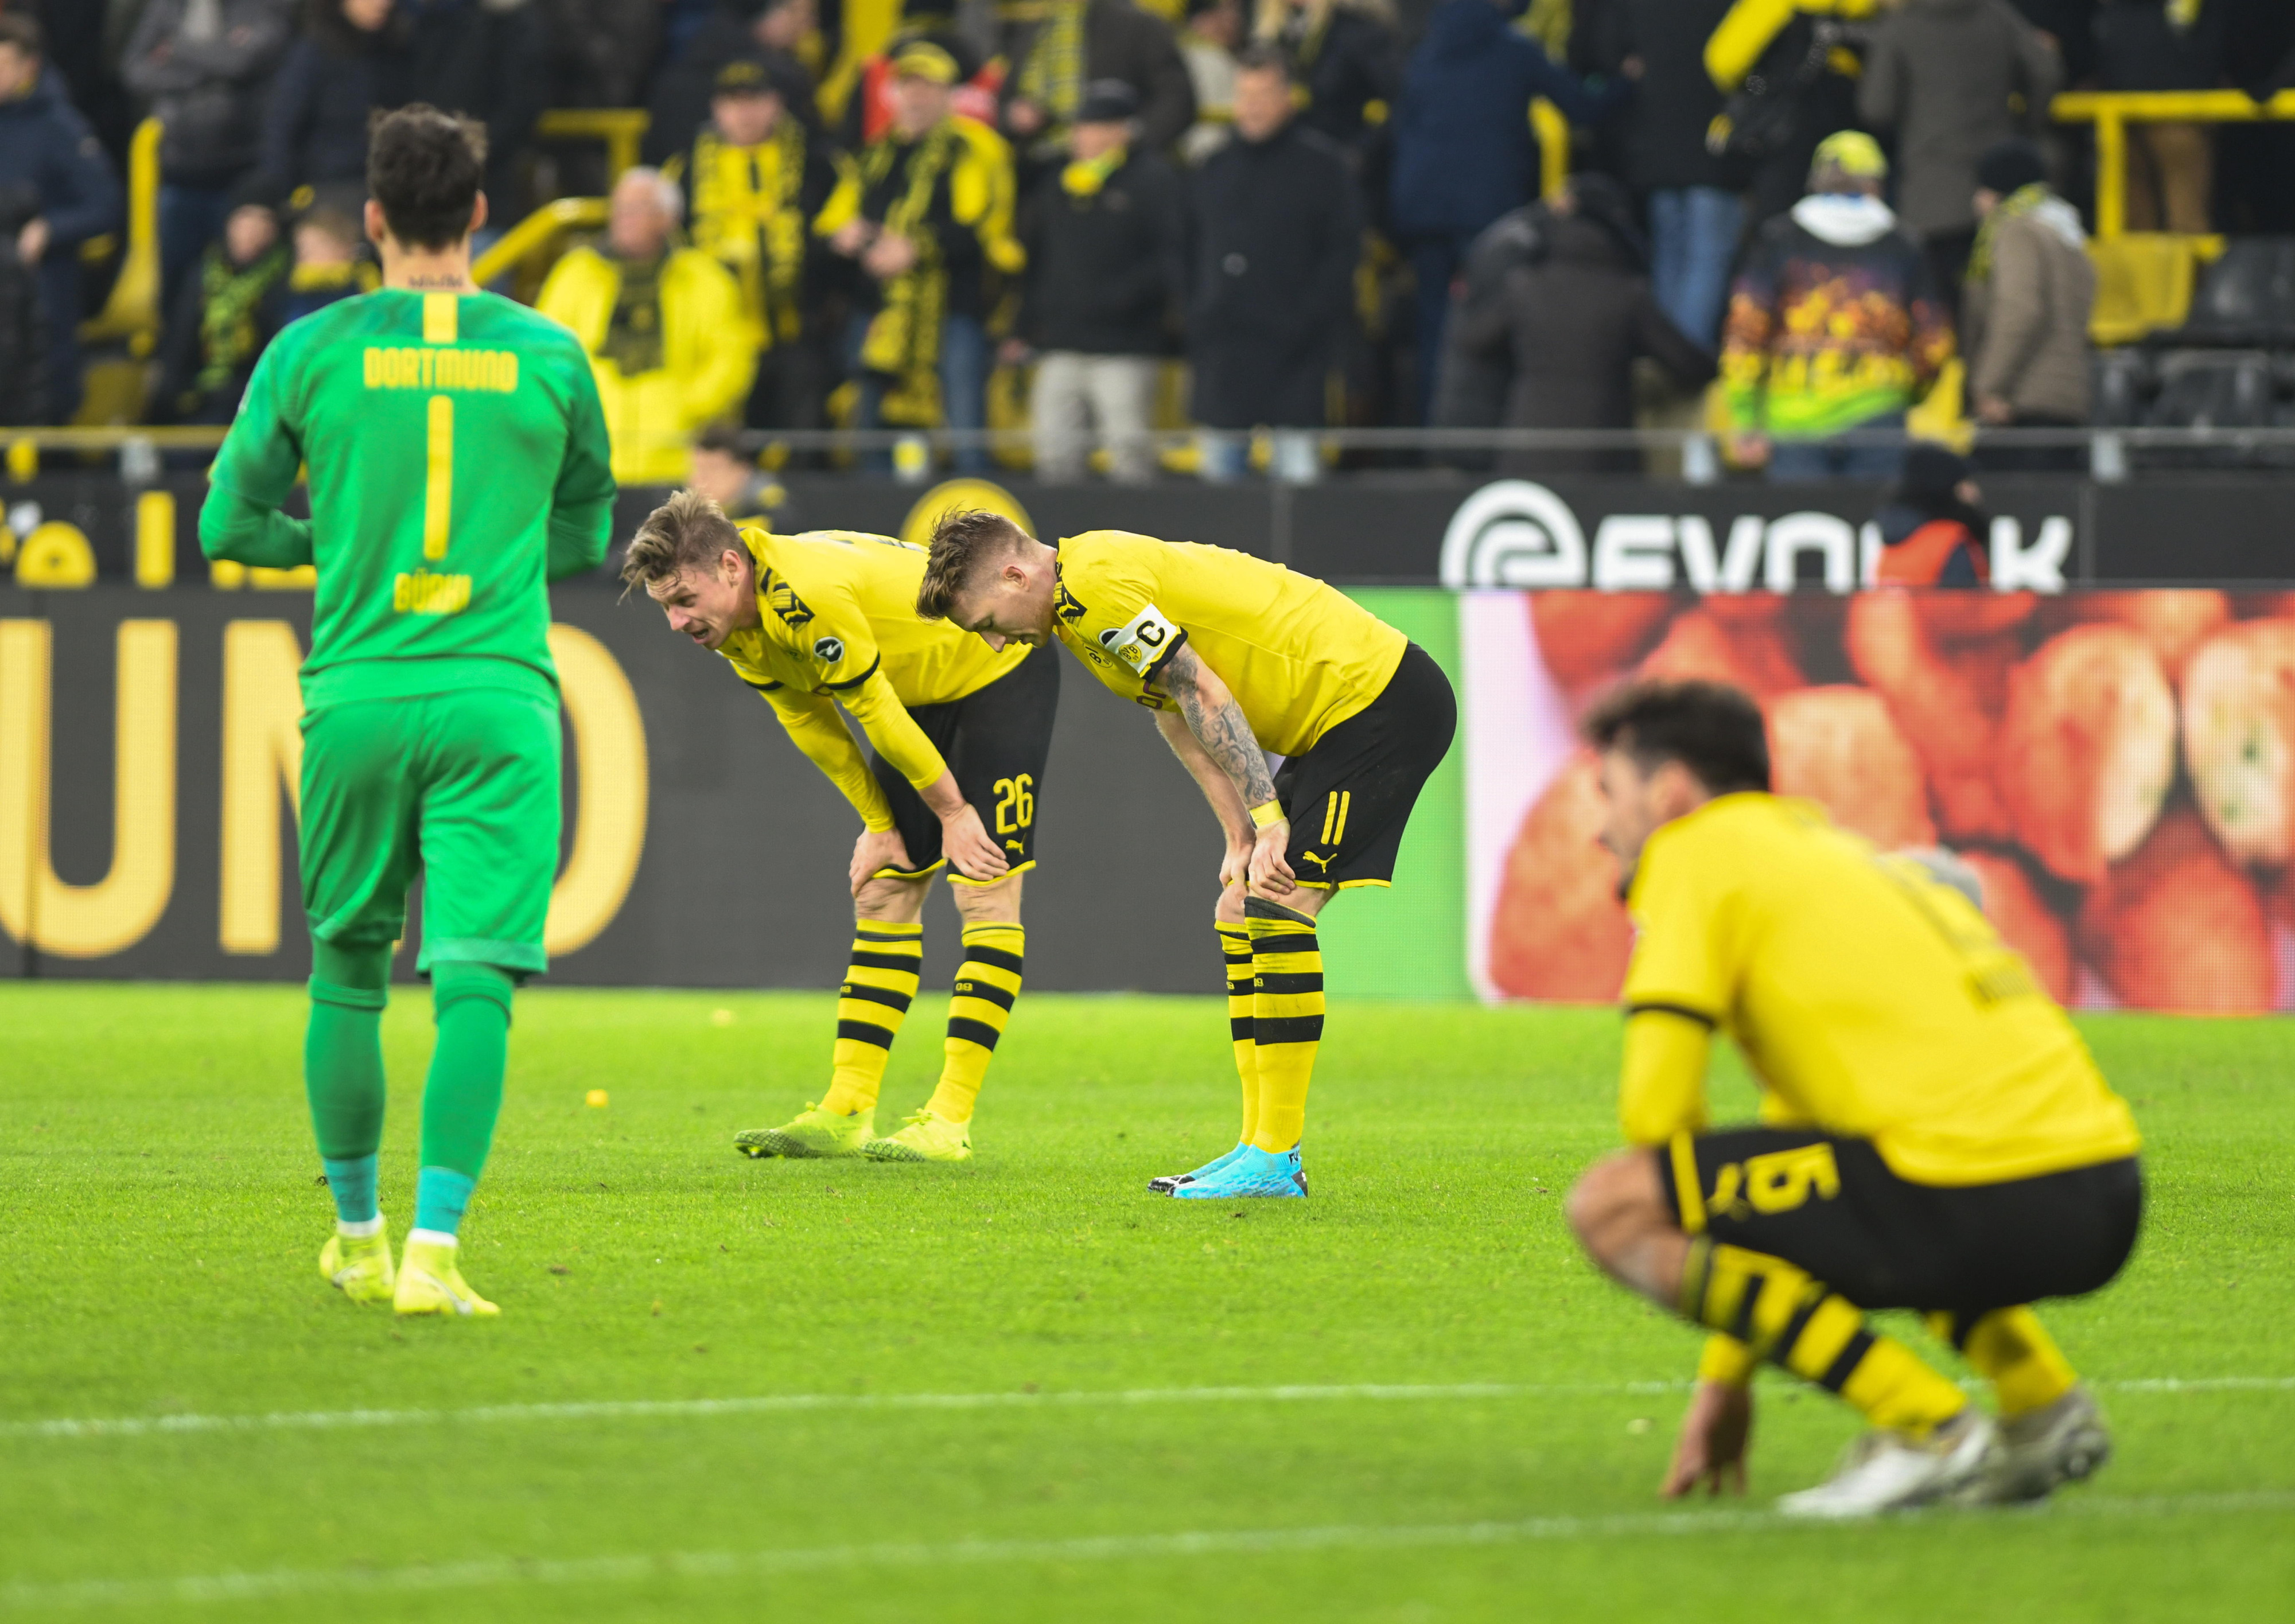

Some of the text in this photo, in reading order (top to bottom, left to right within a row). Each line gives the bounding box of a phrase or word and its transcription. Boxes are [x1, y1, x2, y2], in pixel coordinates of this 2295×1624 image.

[363, 346, 519, 392] DORTMUND
[425, 394, 454, 561] 1
[1136, 620, 1165, 647] C
[993, 773, 1033, 835] 26
[1320, 790, 1351, 846] 11
[956, 983, 973, 991] 09
